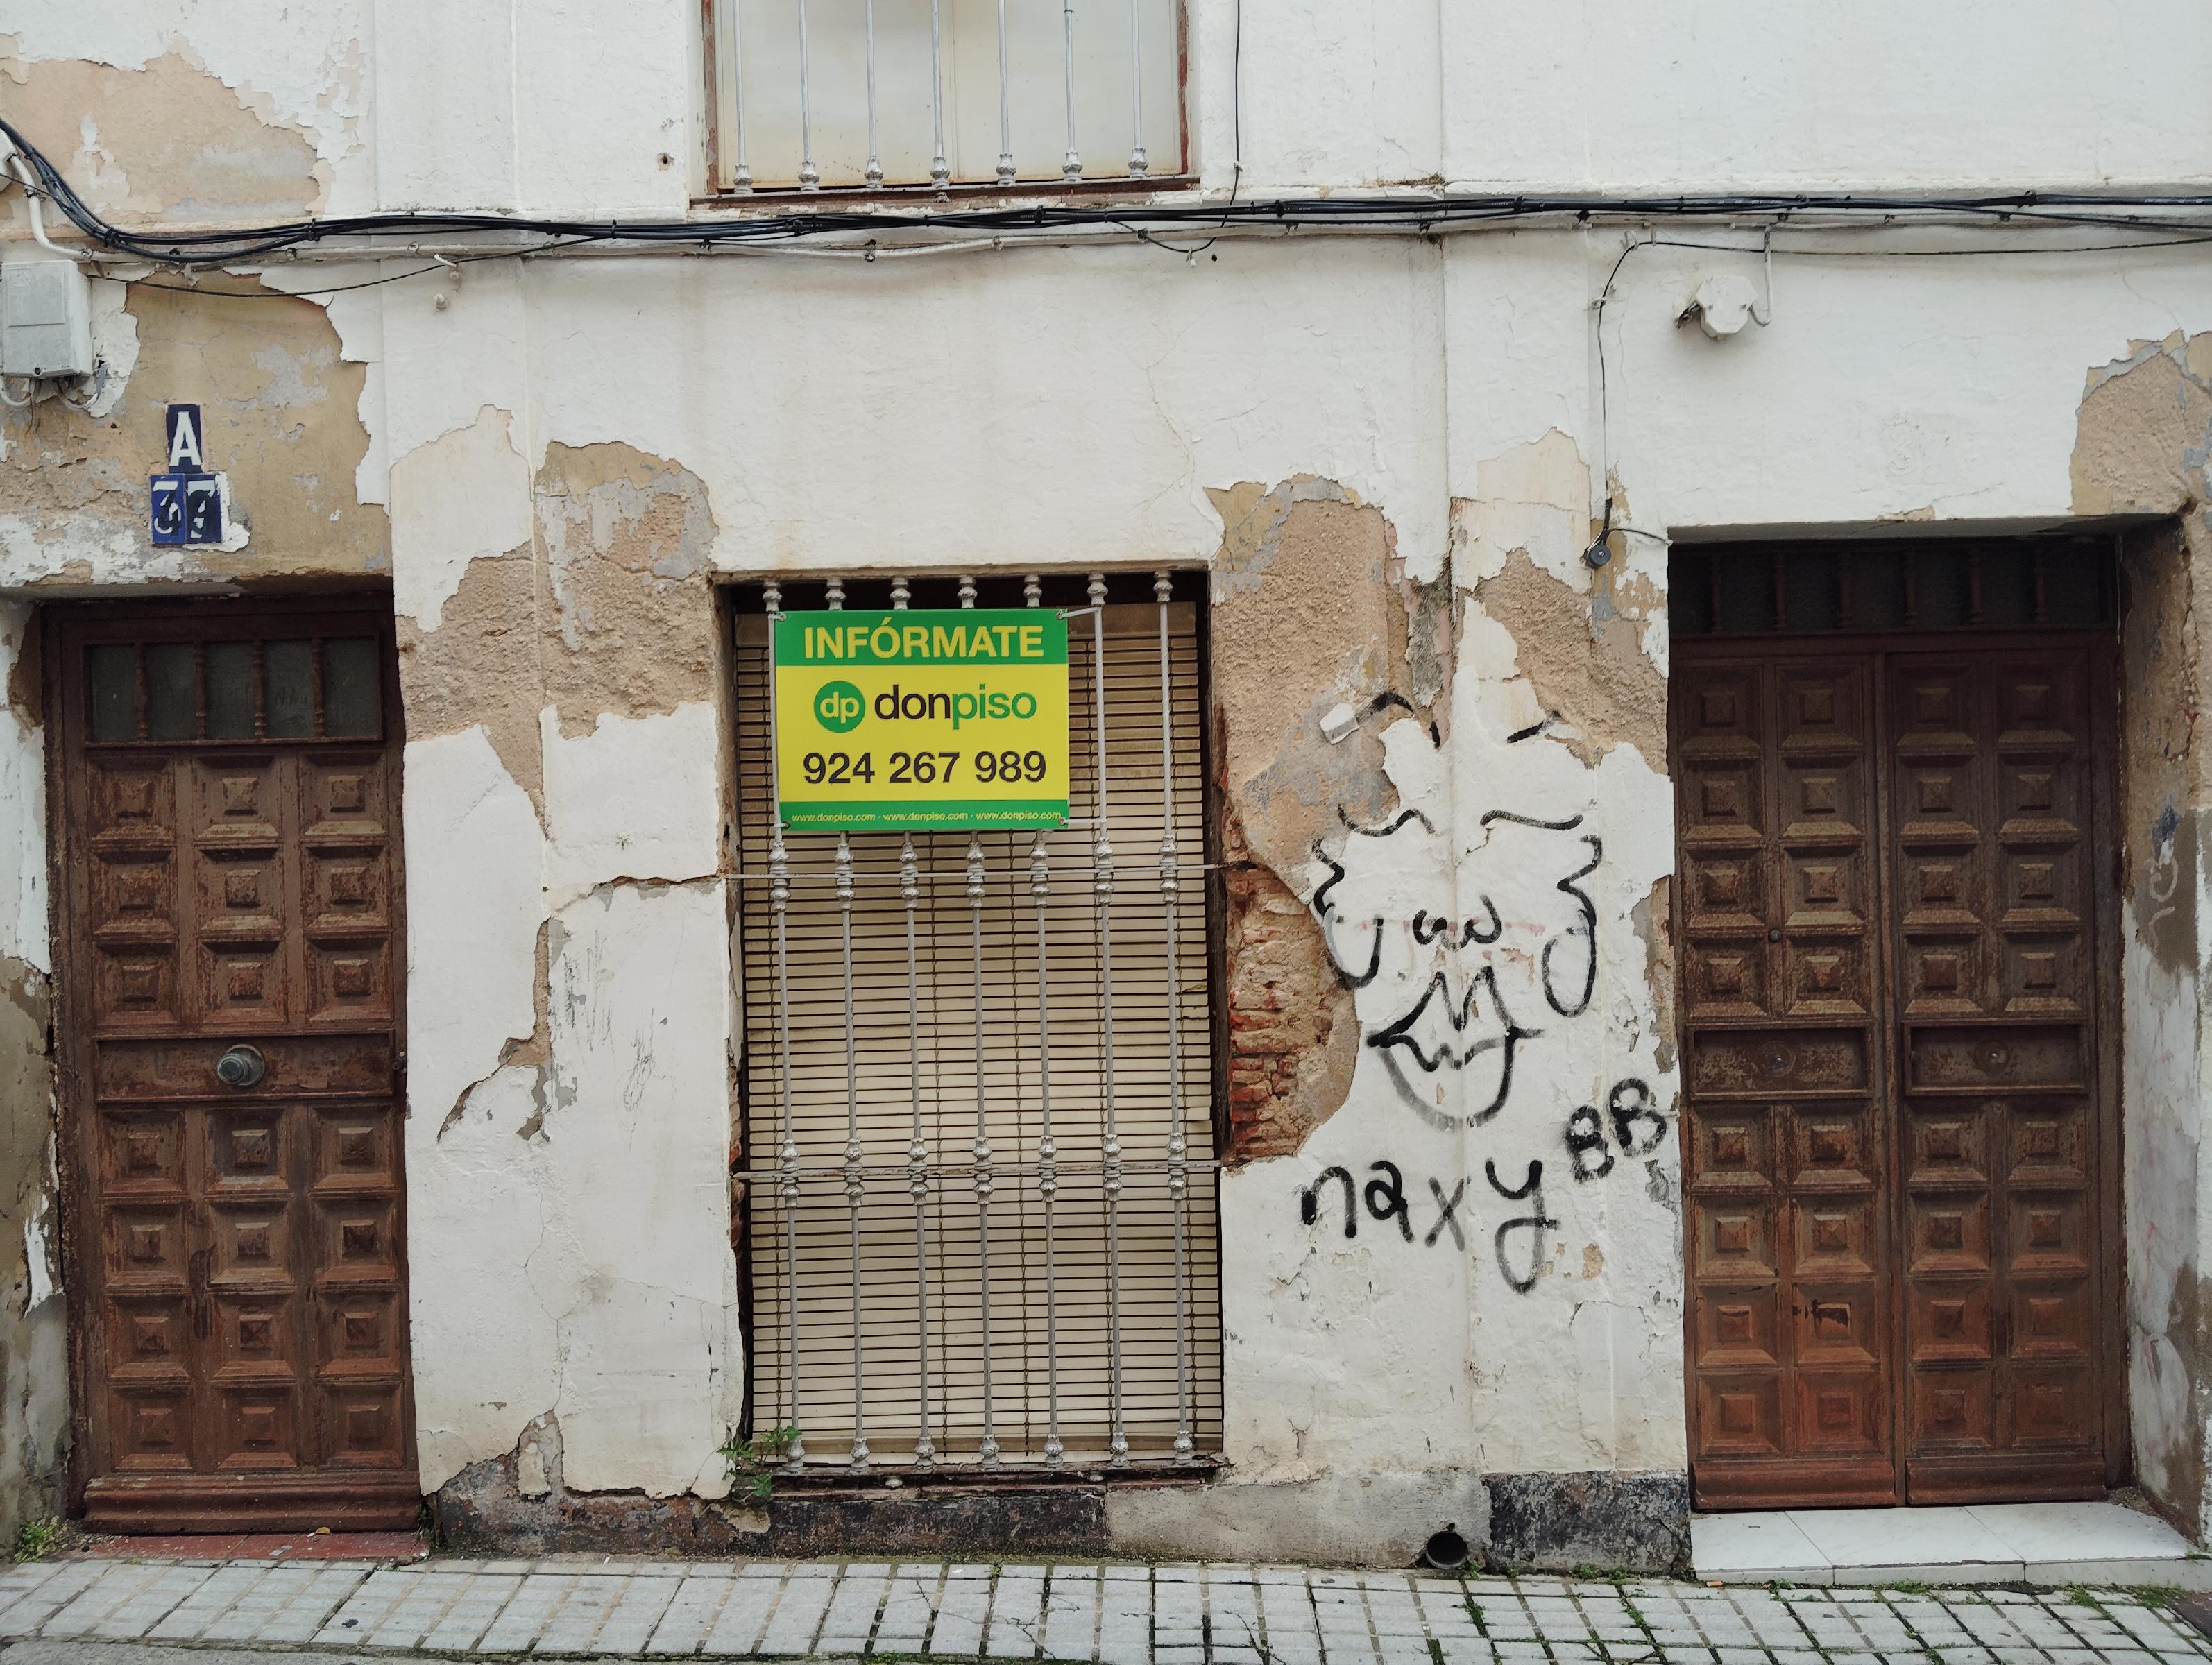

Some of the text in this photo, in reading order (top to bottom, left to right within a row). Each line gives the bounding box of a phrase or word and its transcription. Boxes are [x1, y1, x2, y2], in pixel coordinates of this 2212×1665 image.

[169, 411, 201, 466] A
[804, 616, 1044, 659] INFÓRMATE
[819, 683, 1037, 731] dp donpiso
[803, 751, 1046, 785] 924 267 989
[792, 810, 1062, 823] www.donpiso.com www.donpiso.com www.donpiso.com
